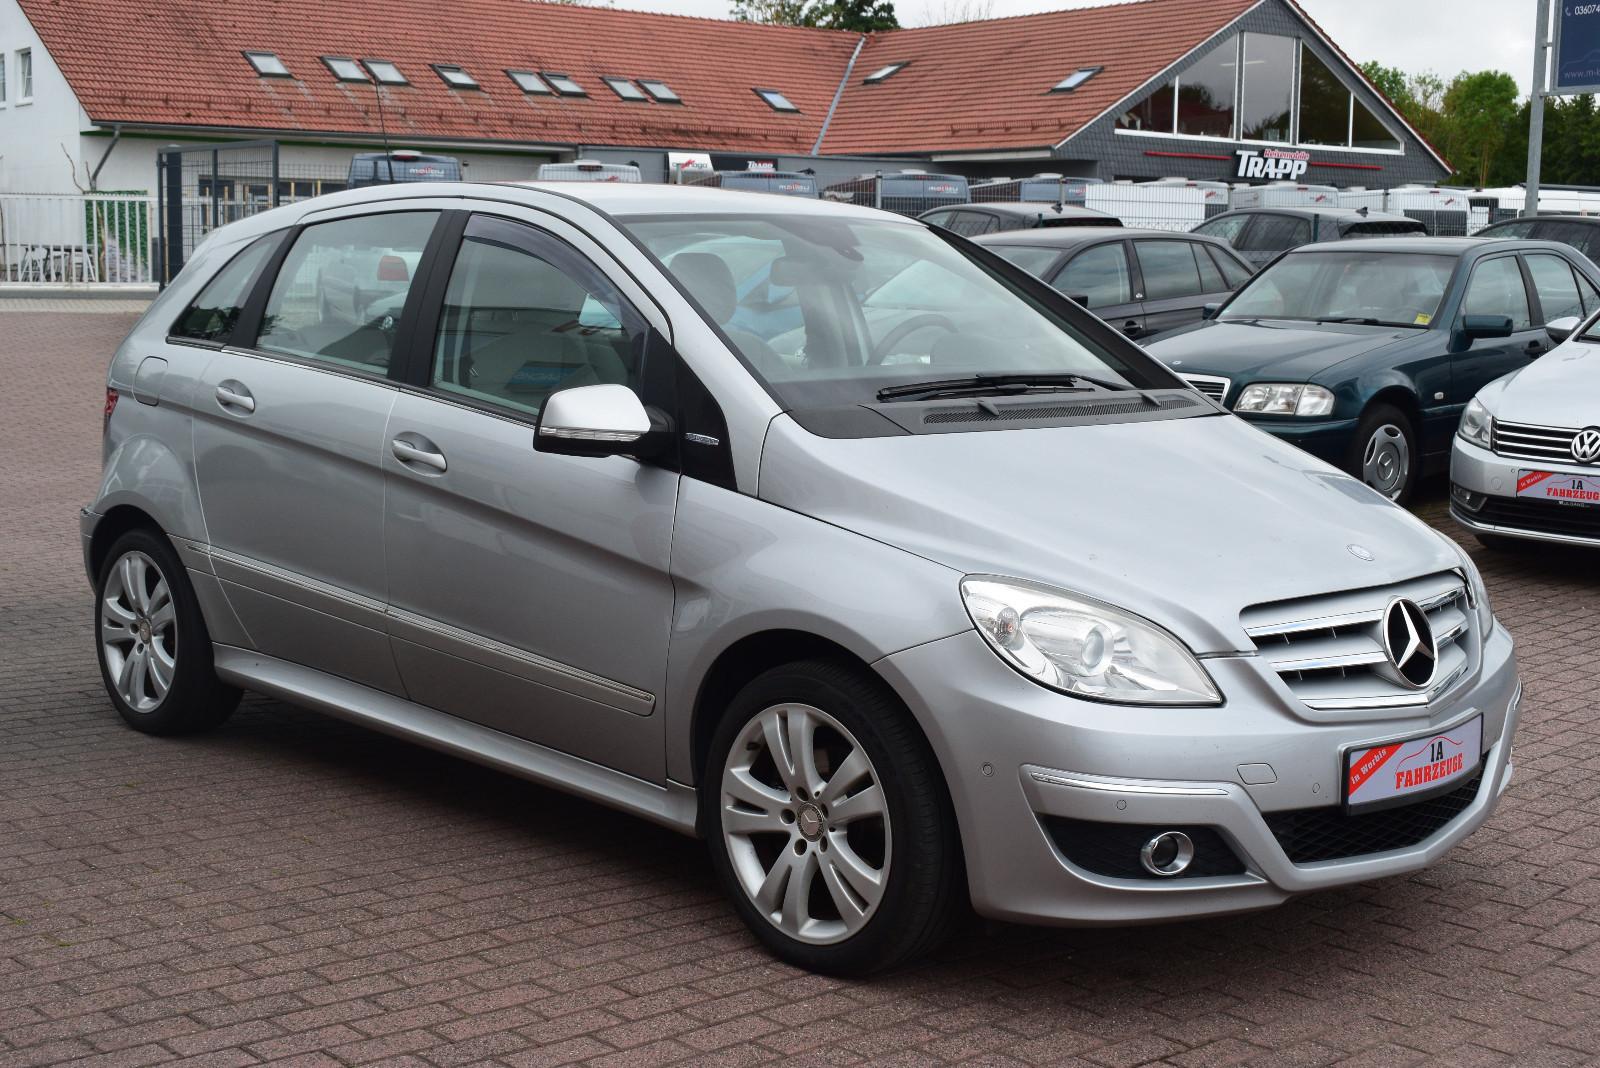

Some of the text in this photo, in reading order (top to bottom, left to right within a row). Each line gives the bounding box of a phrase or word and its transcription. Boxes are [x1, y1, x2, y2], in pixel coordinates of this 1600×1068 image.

[1236, 150, 1307, 180] TRAPP
[1351, 748, 1387, 785] in Worbis
[1430, 741, 1444, 762] 1A
[1395, 752, 1463, 790] FAHRZEUGE
